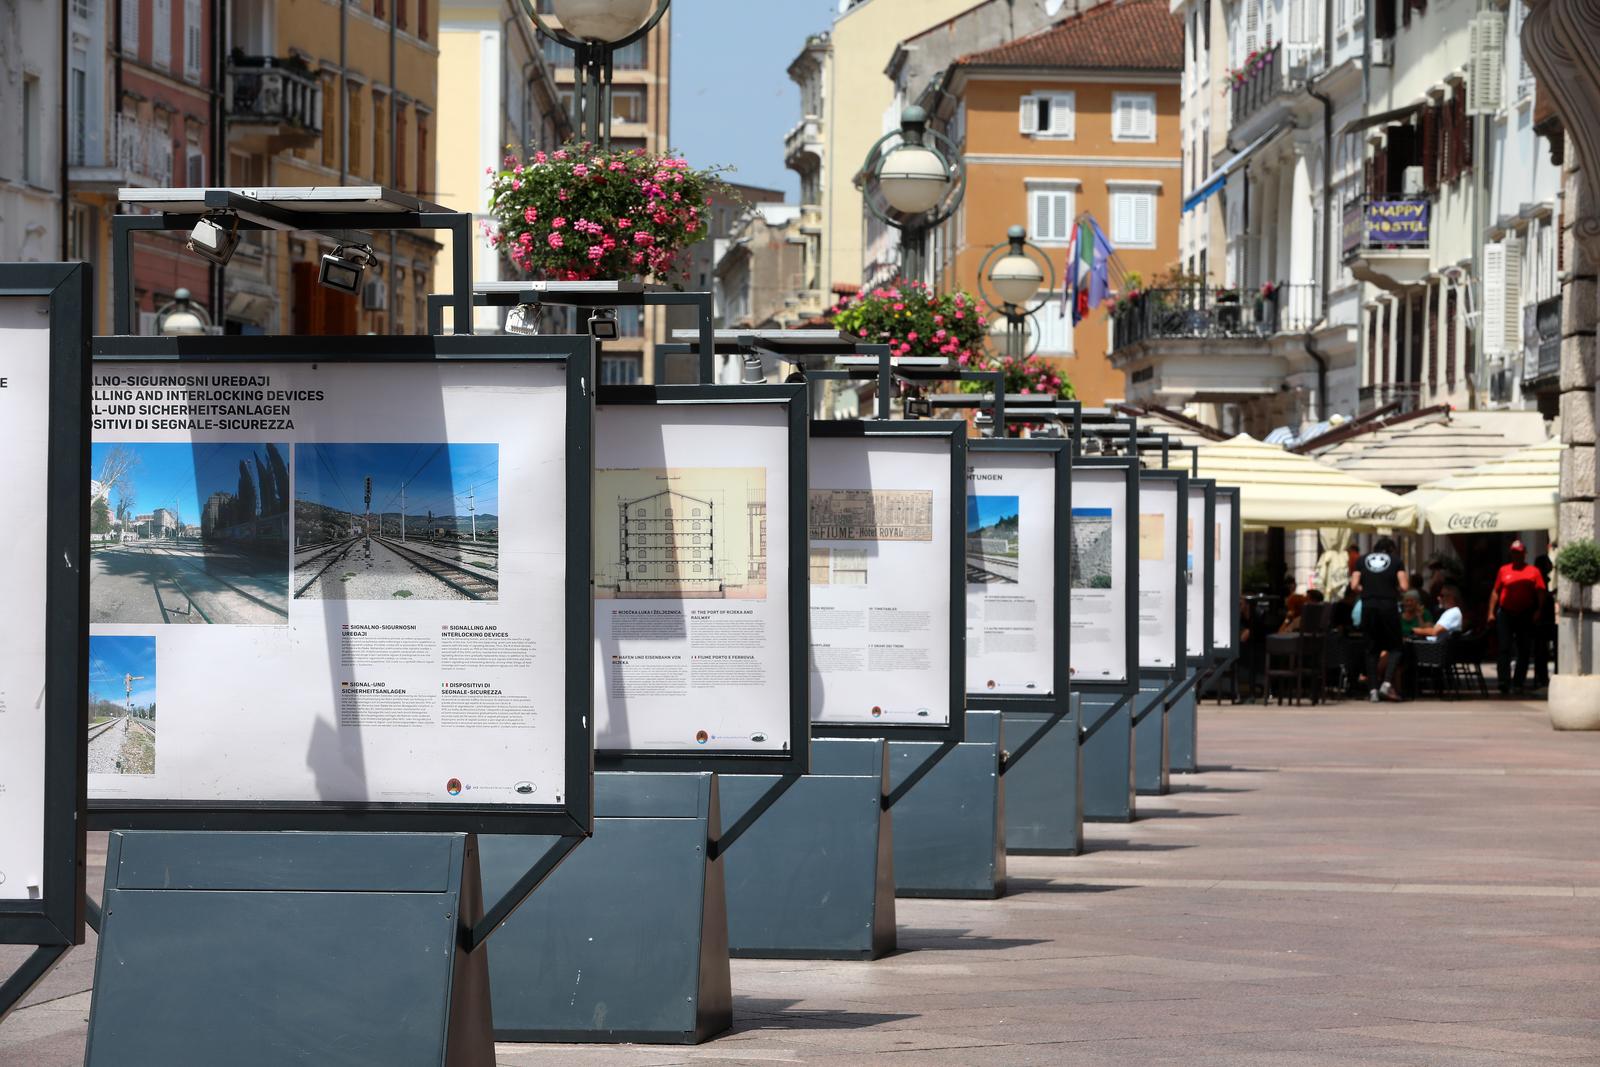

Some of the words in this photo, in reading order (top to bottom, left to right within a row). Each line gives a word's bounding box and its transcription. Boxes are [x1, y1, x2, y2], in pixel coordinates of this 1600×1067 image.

[1371, 204, 1424, 217] HAPPY
[91, 376, 208, 386] LNO-SIGURNOSNI
[212, 376, 270, 386] UREĐAJI
[136, 390, 163, 401] AND
[167, 390, 264, 401] INTERLOCKING
[267, 390, 324, 401] DEVICES
[139, 404, 290, 416] SICHERHEITSANLAGEN
[91, 419, 132, 430] SITIVI
[136, 419, 148, 430] DI
[151, 419, 294, 430] SEGNALE-SICUREZZA
[820, 527, 855, 538] FIUME
[879, 528, 904, 537] ROYAL
